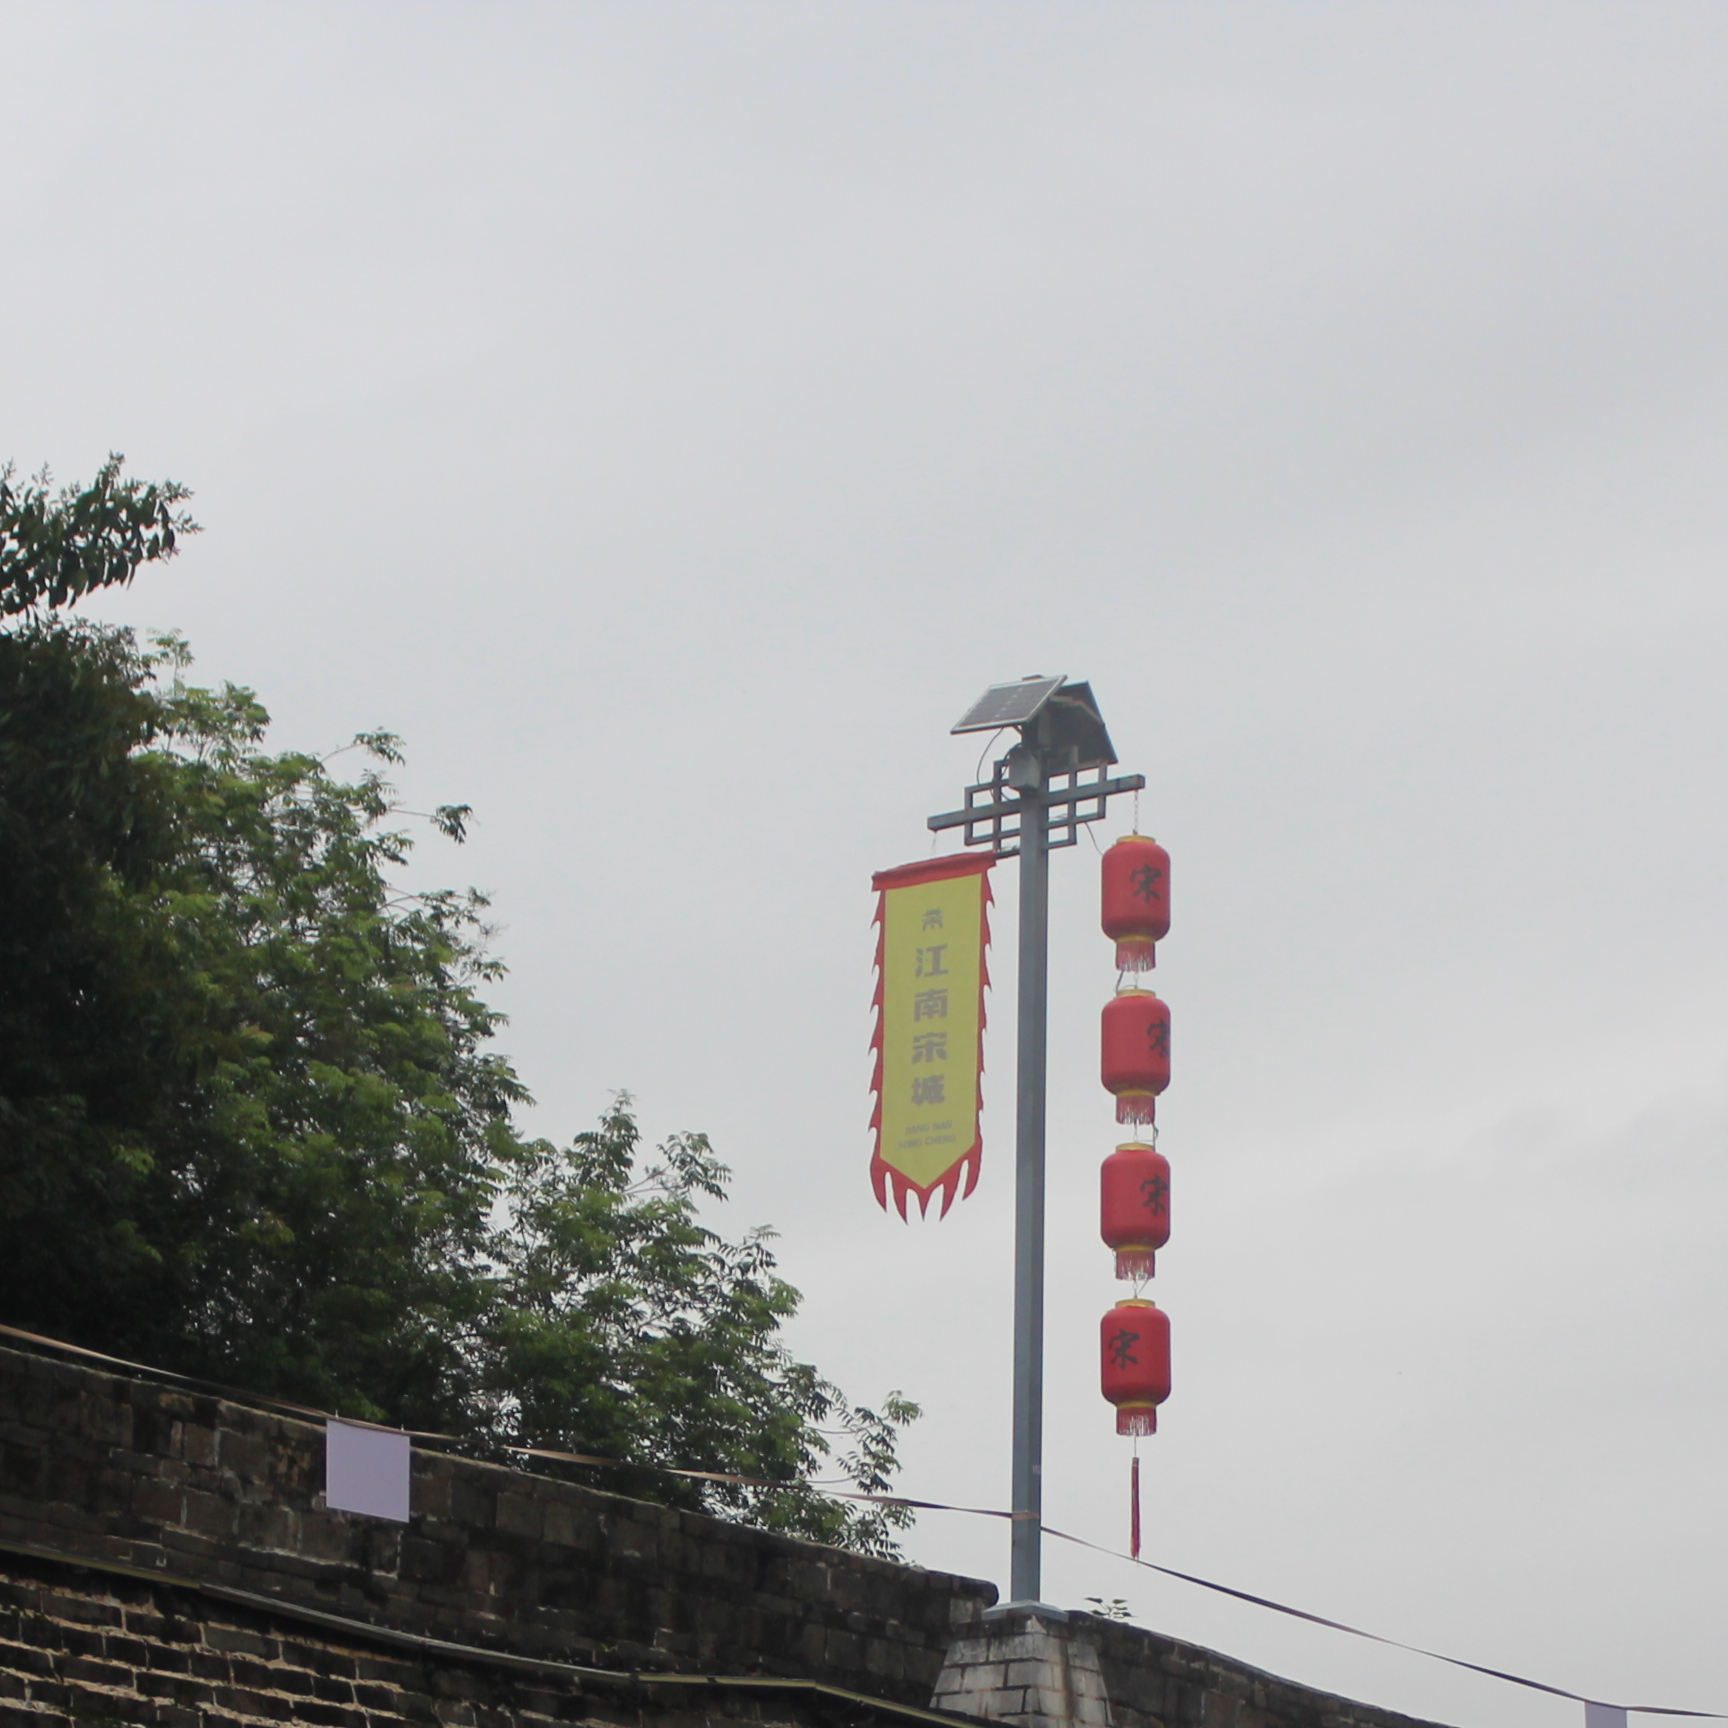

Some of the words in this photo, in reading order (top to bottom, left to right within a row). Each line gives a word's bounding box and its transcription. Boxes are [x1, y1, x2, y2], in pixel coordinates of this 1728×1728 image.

[1129, 864, 1163, 905] 宋
[911, 944, 949, 1107] 江南宋城
[1139, 1175, 1168, 1216] 宋
[1108, 1329, 1141, 1369] 宋
